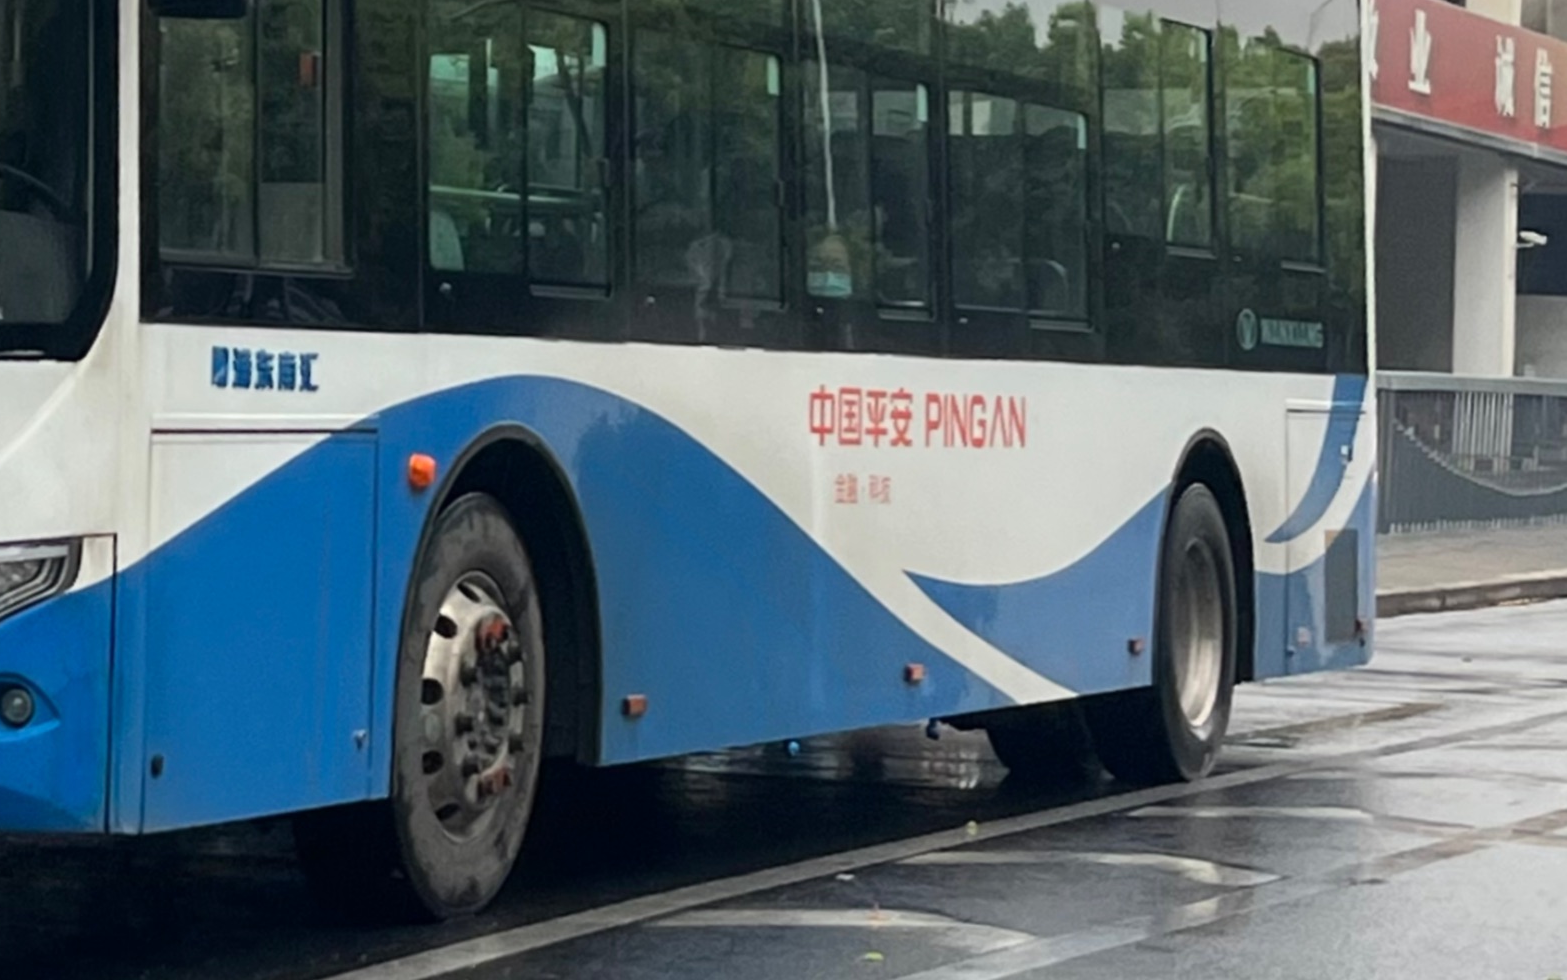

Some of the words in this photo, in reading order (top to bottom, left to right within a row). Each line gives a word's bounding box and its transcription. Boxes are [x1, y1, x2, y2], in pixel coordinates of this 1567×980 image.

[808, 384, 914, 448] 中国平安
[924, 392, 1027, 449] PINGAN
